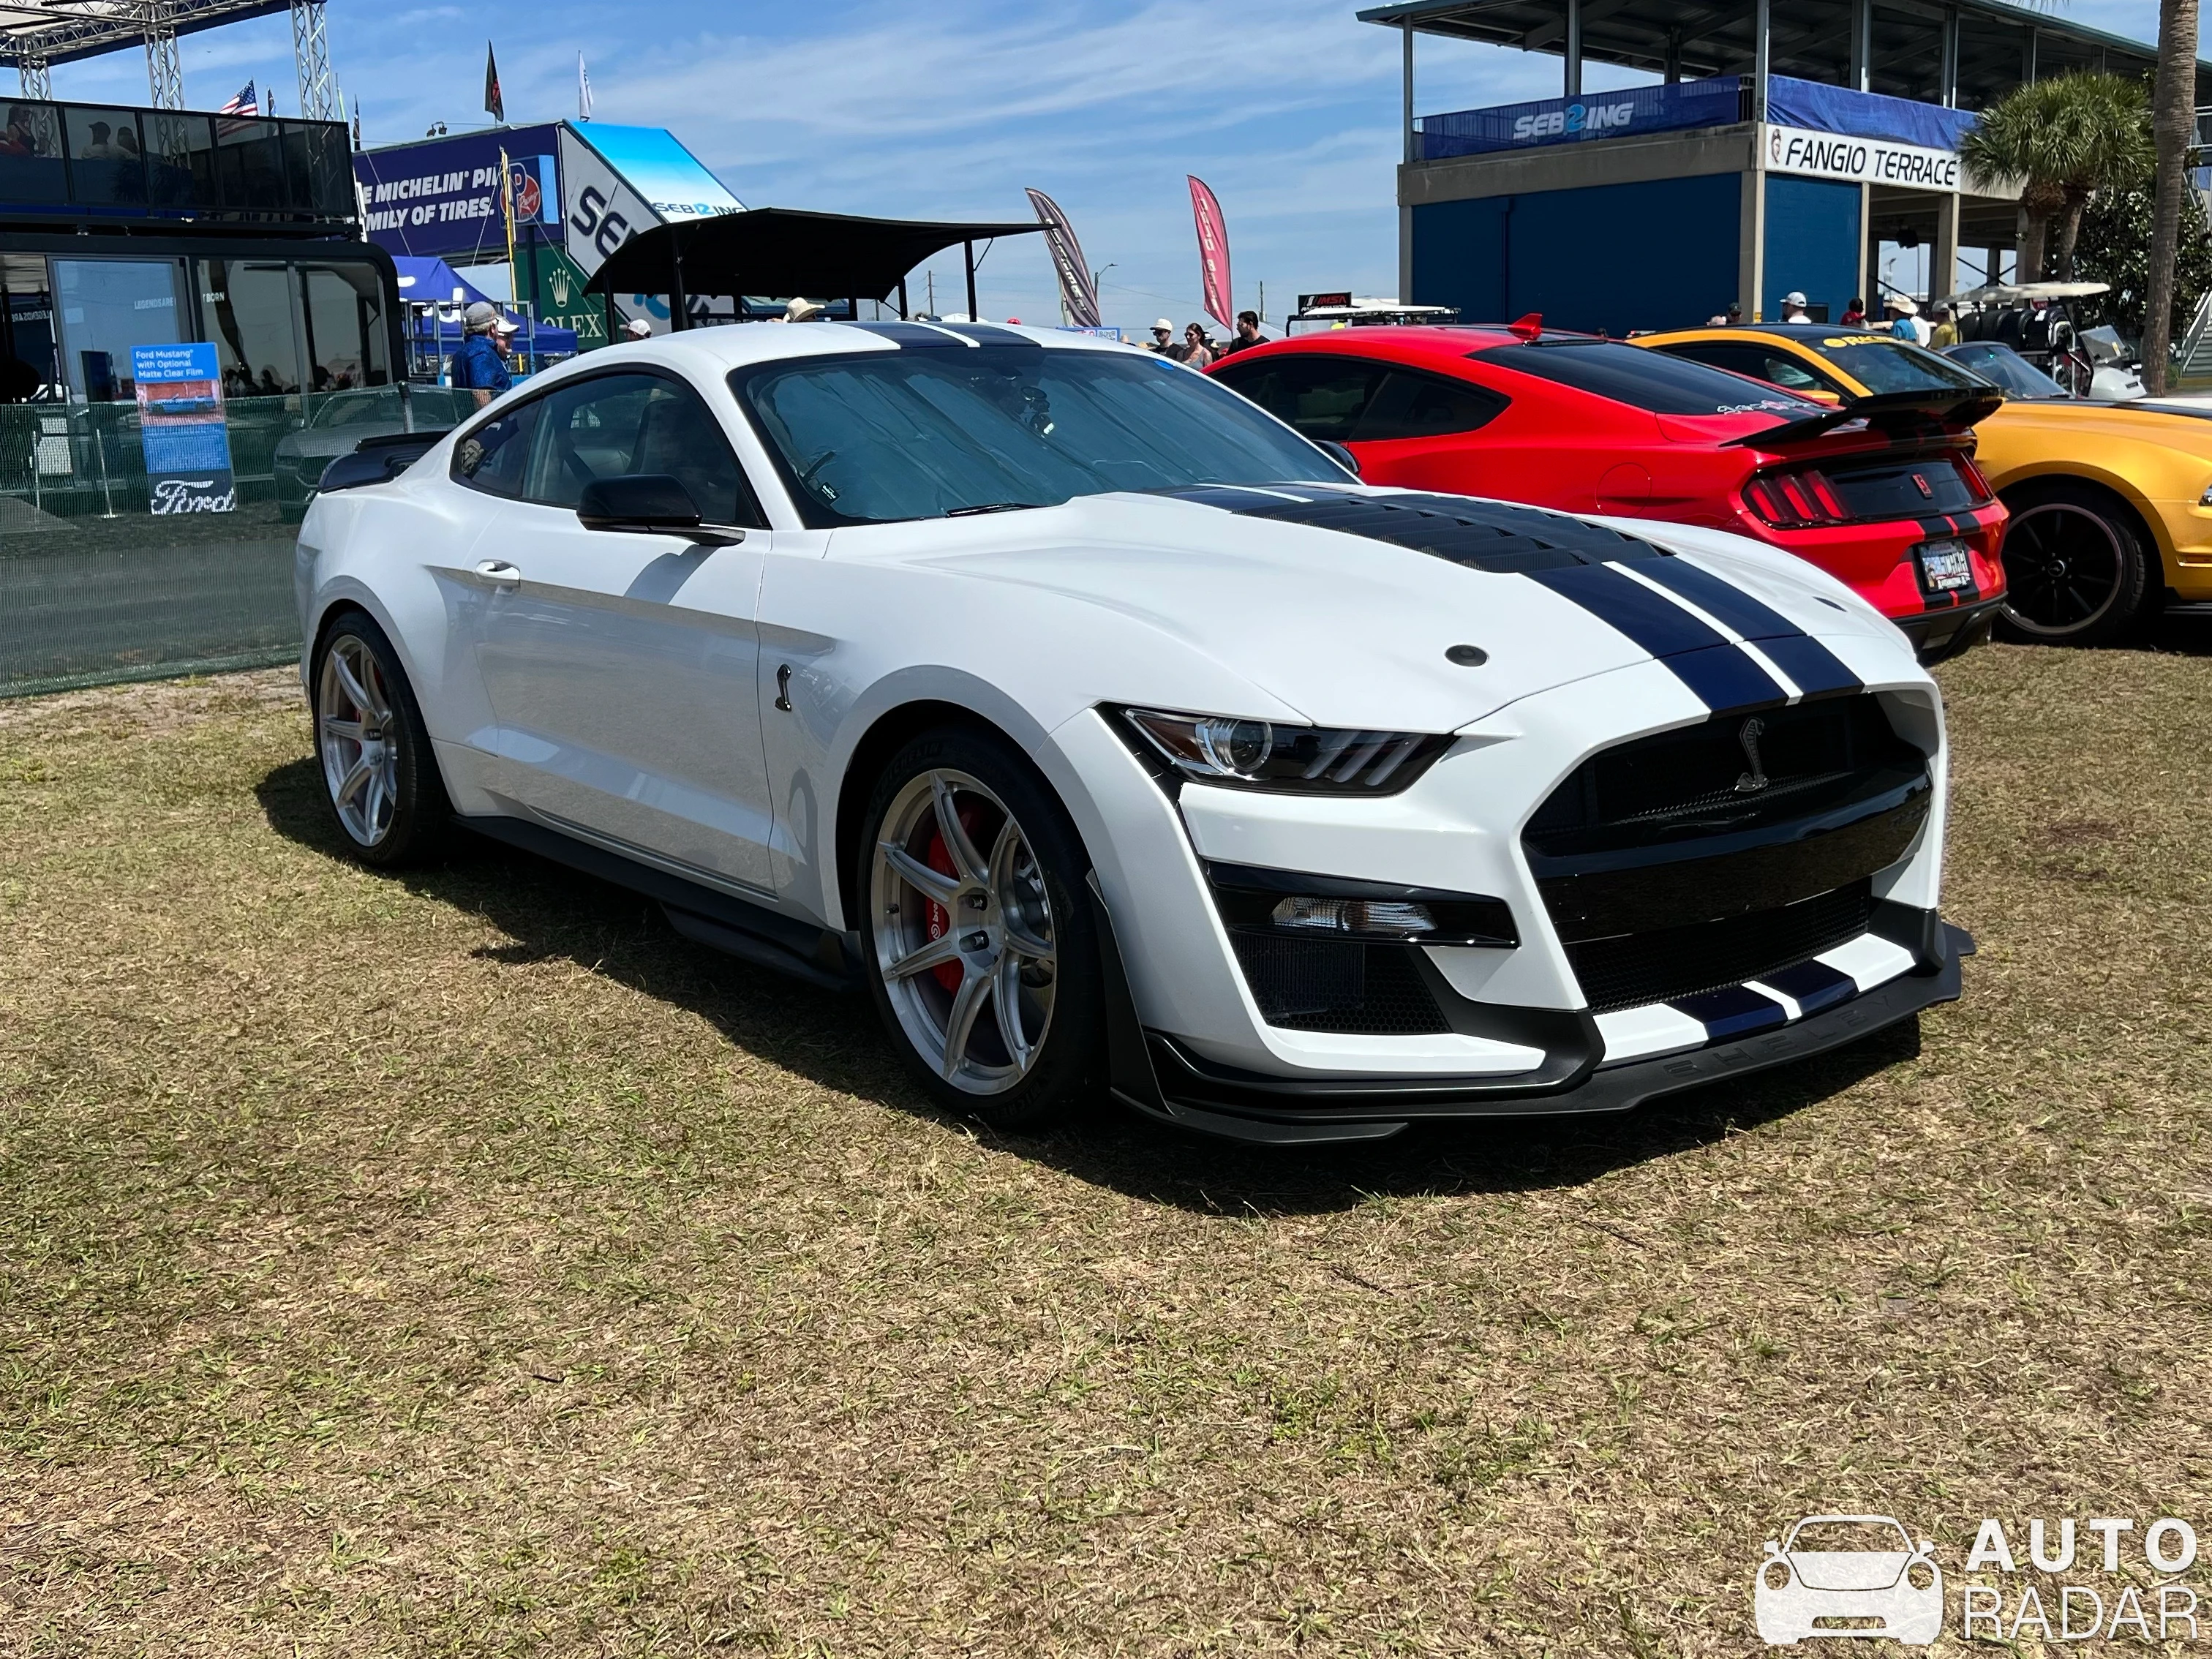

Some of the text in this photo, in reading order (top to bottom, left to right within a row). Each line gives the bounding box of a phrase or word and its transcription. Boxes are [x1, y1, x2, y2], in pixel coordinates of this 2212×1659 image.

[1785, 138, 1957, 186] FANGIO TERRACE
[411, 204, 437, 226] OF
[439, 196, 494, 222] TIRES.
[134, 296, 173, 310] LEGENDS ARE
[1317, 295, 1347, 305] IMSA
[135, 350, 154, 359] Ford
[137, 358, 192, 369] with Optional
[138, 368, 204, 379] Matte Clear Film
[150, 479, 237, 515] Ford
[1663, 994, 1892, 1077] SHELBY
